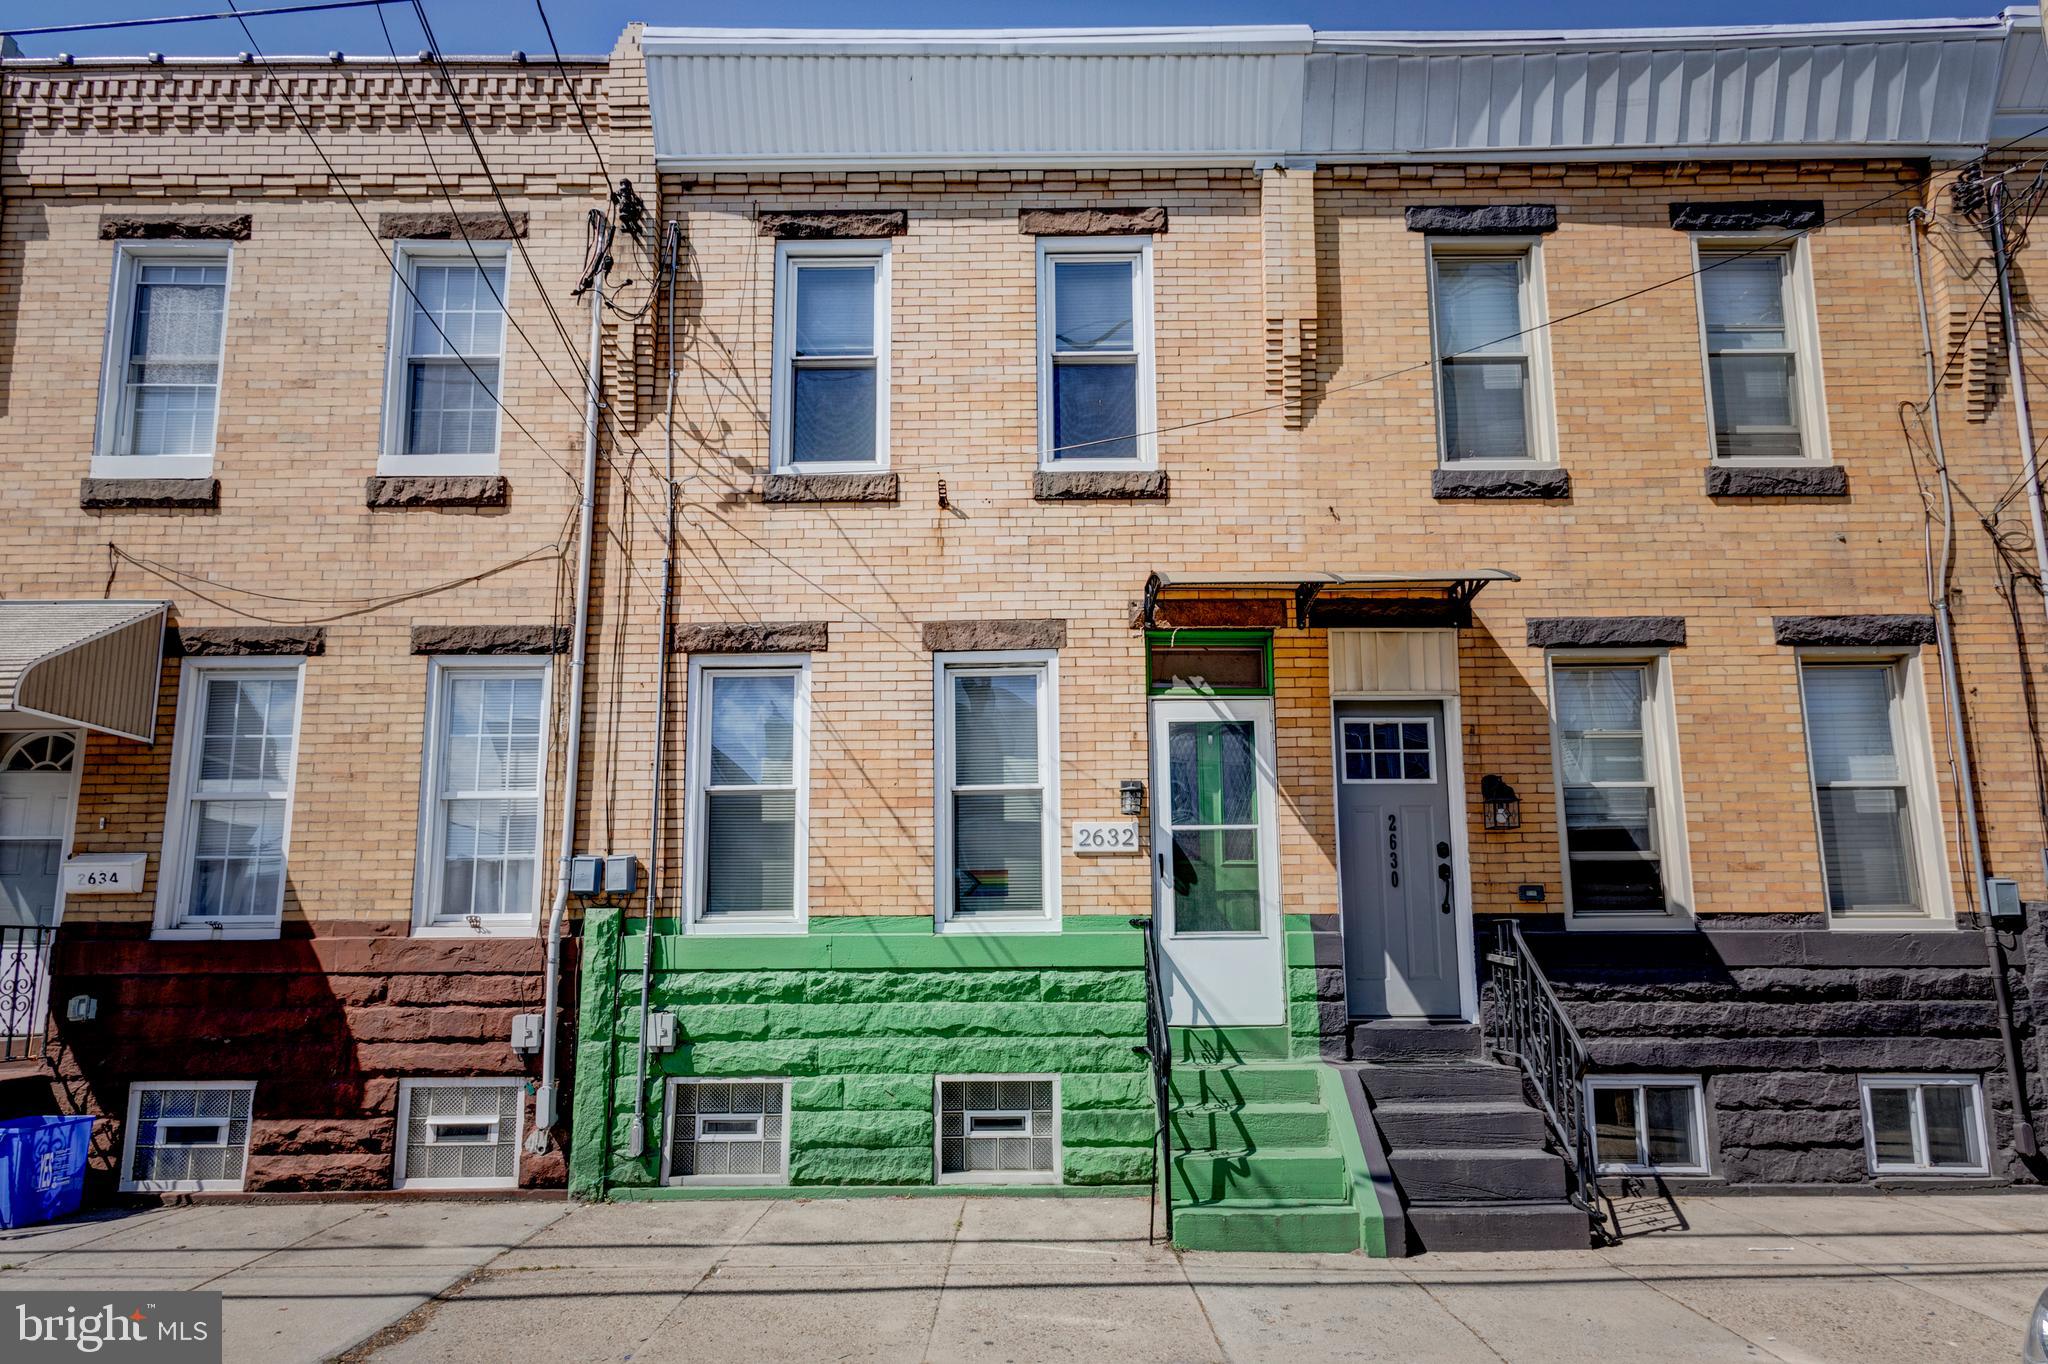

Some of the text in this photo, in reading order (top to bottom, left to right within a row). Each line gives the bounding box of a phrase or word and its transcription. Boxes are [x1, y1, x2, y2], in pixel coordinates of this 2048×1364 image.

[1079, 828, 1134, 847] 2632
[1388, 814, 1399, 888] 2630
[77, 872, 119, 885] 2634
